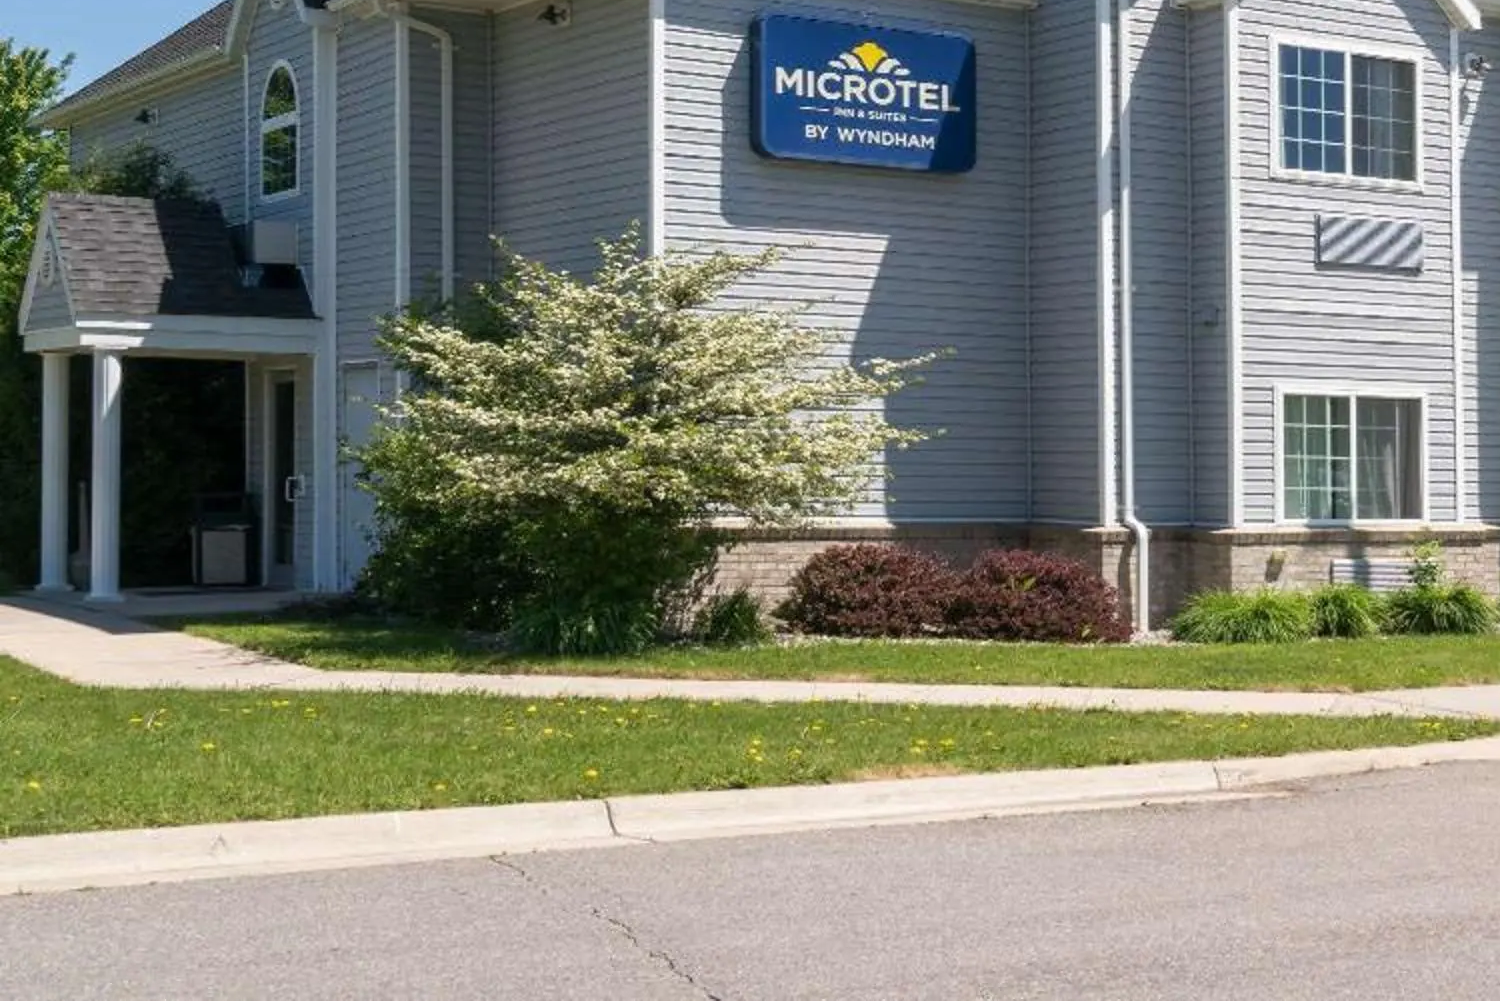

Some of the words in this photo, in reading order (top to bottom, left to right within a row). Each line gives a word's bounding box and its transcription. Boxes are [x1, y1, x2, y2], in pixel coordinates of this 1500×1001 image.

[774, 66, 961, 112] MICROTEL
[804, 124, 829, 140] BY
[837, 126, 935, 150] WYNDHAM
